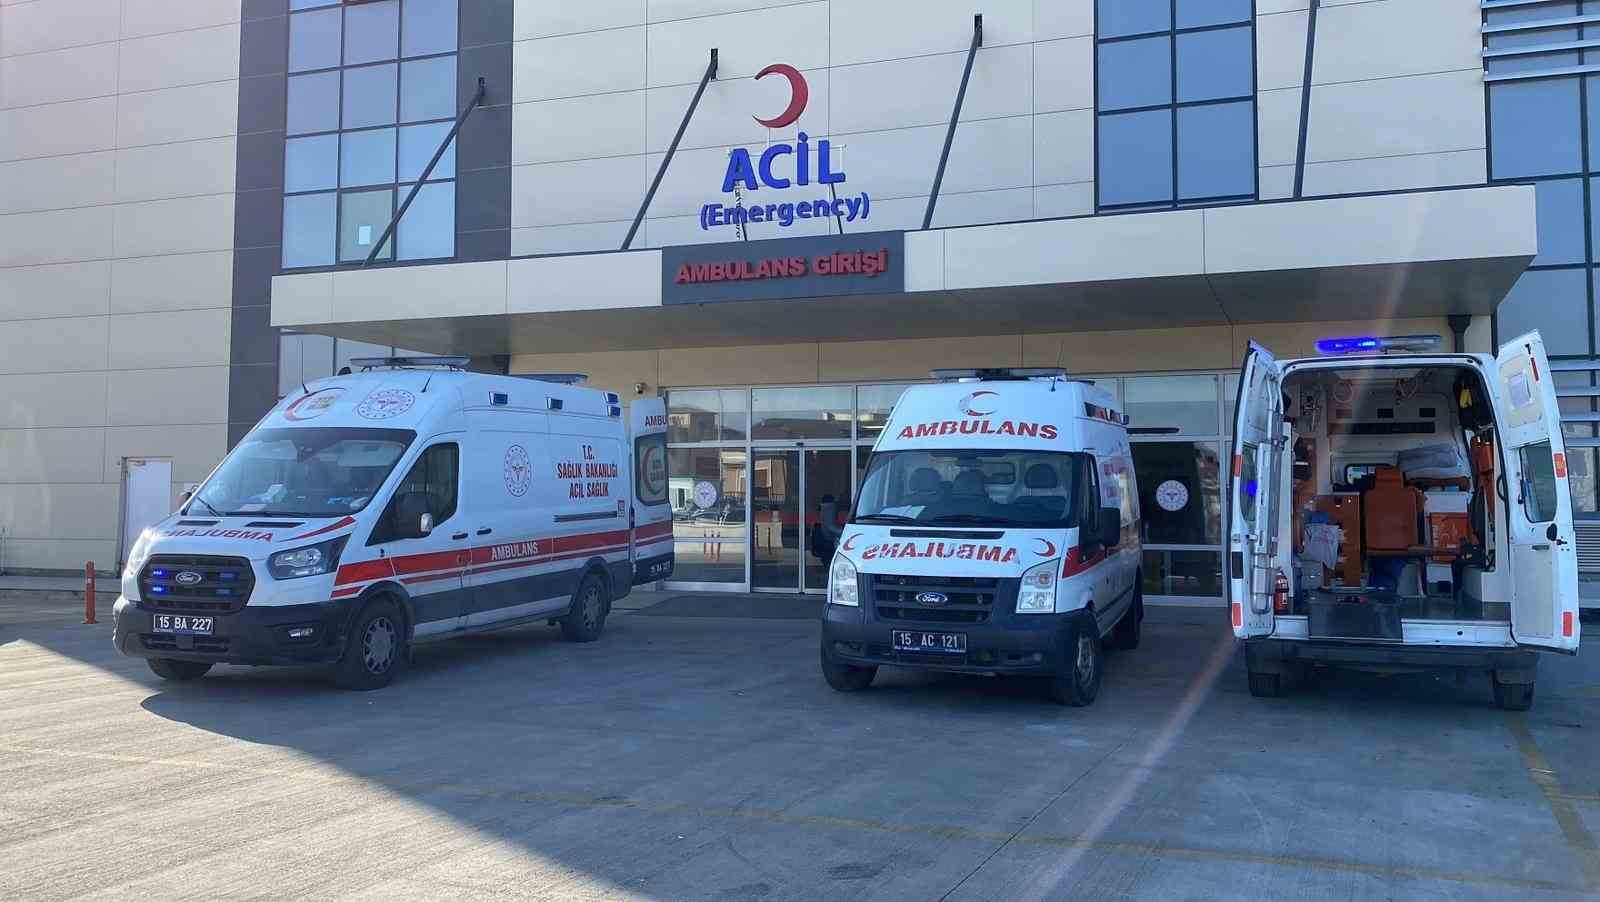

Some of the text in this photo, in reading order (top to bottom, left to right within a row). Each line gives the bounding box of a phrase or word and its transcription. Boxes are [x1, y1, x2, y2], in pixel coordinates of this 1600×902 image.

[722, 132, 846, 192] ACİL
[700, 192, 870, 230] (Emergency)
[675, 248, 887, 284] AMBULANS GİRİŞİ
[897, 420, 1058, 440] AMBULANS
[582, 445, 595, 460] T.C.
[557, 461, 618, 479] SAĞLIK BAKANLIĞI
[586, 480, 609, 497] SAĞLIK
[491, 541, 538, 560] AMBULANS
[159, 616, 212, 631] 15 BA 227
[900, 633, 957, 649] 15 AC 121
